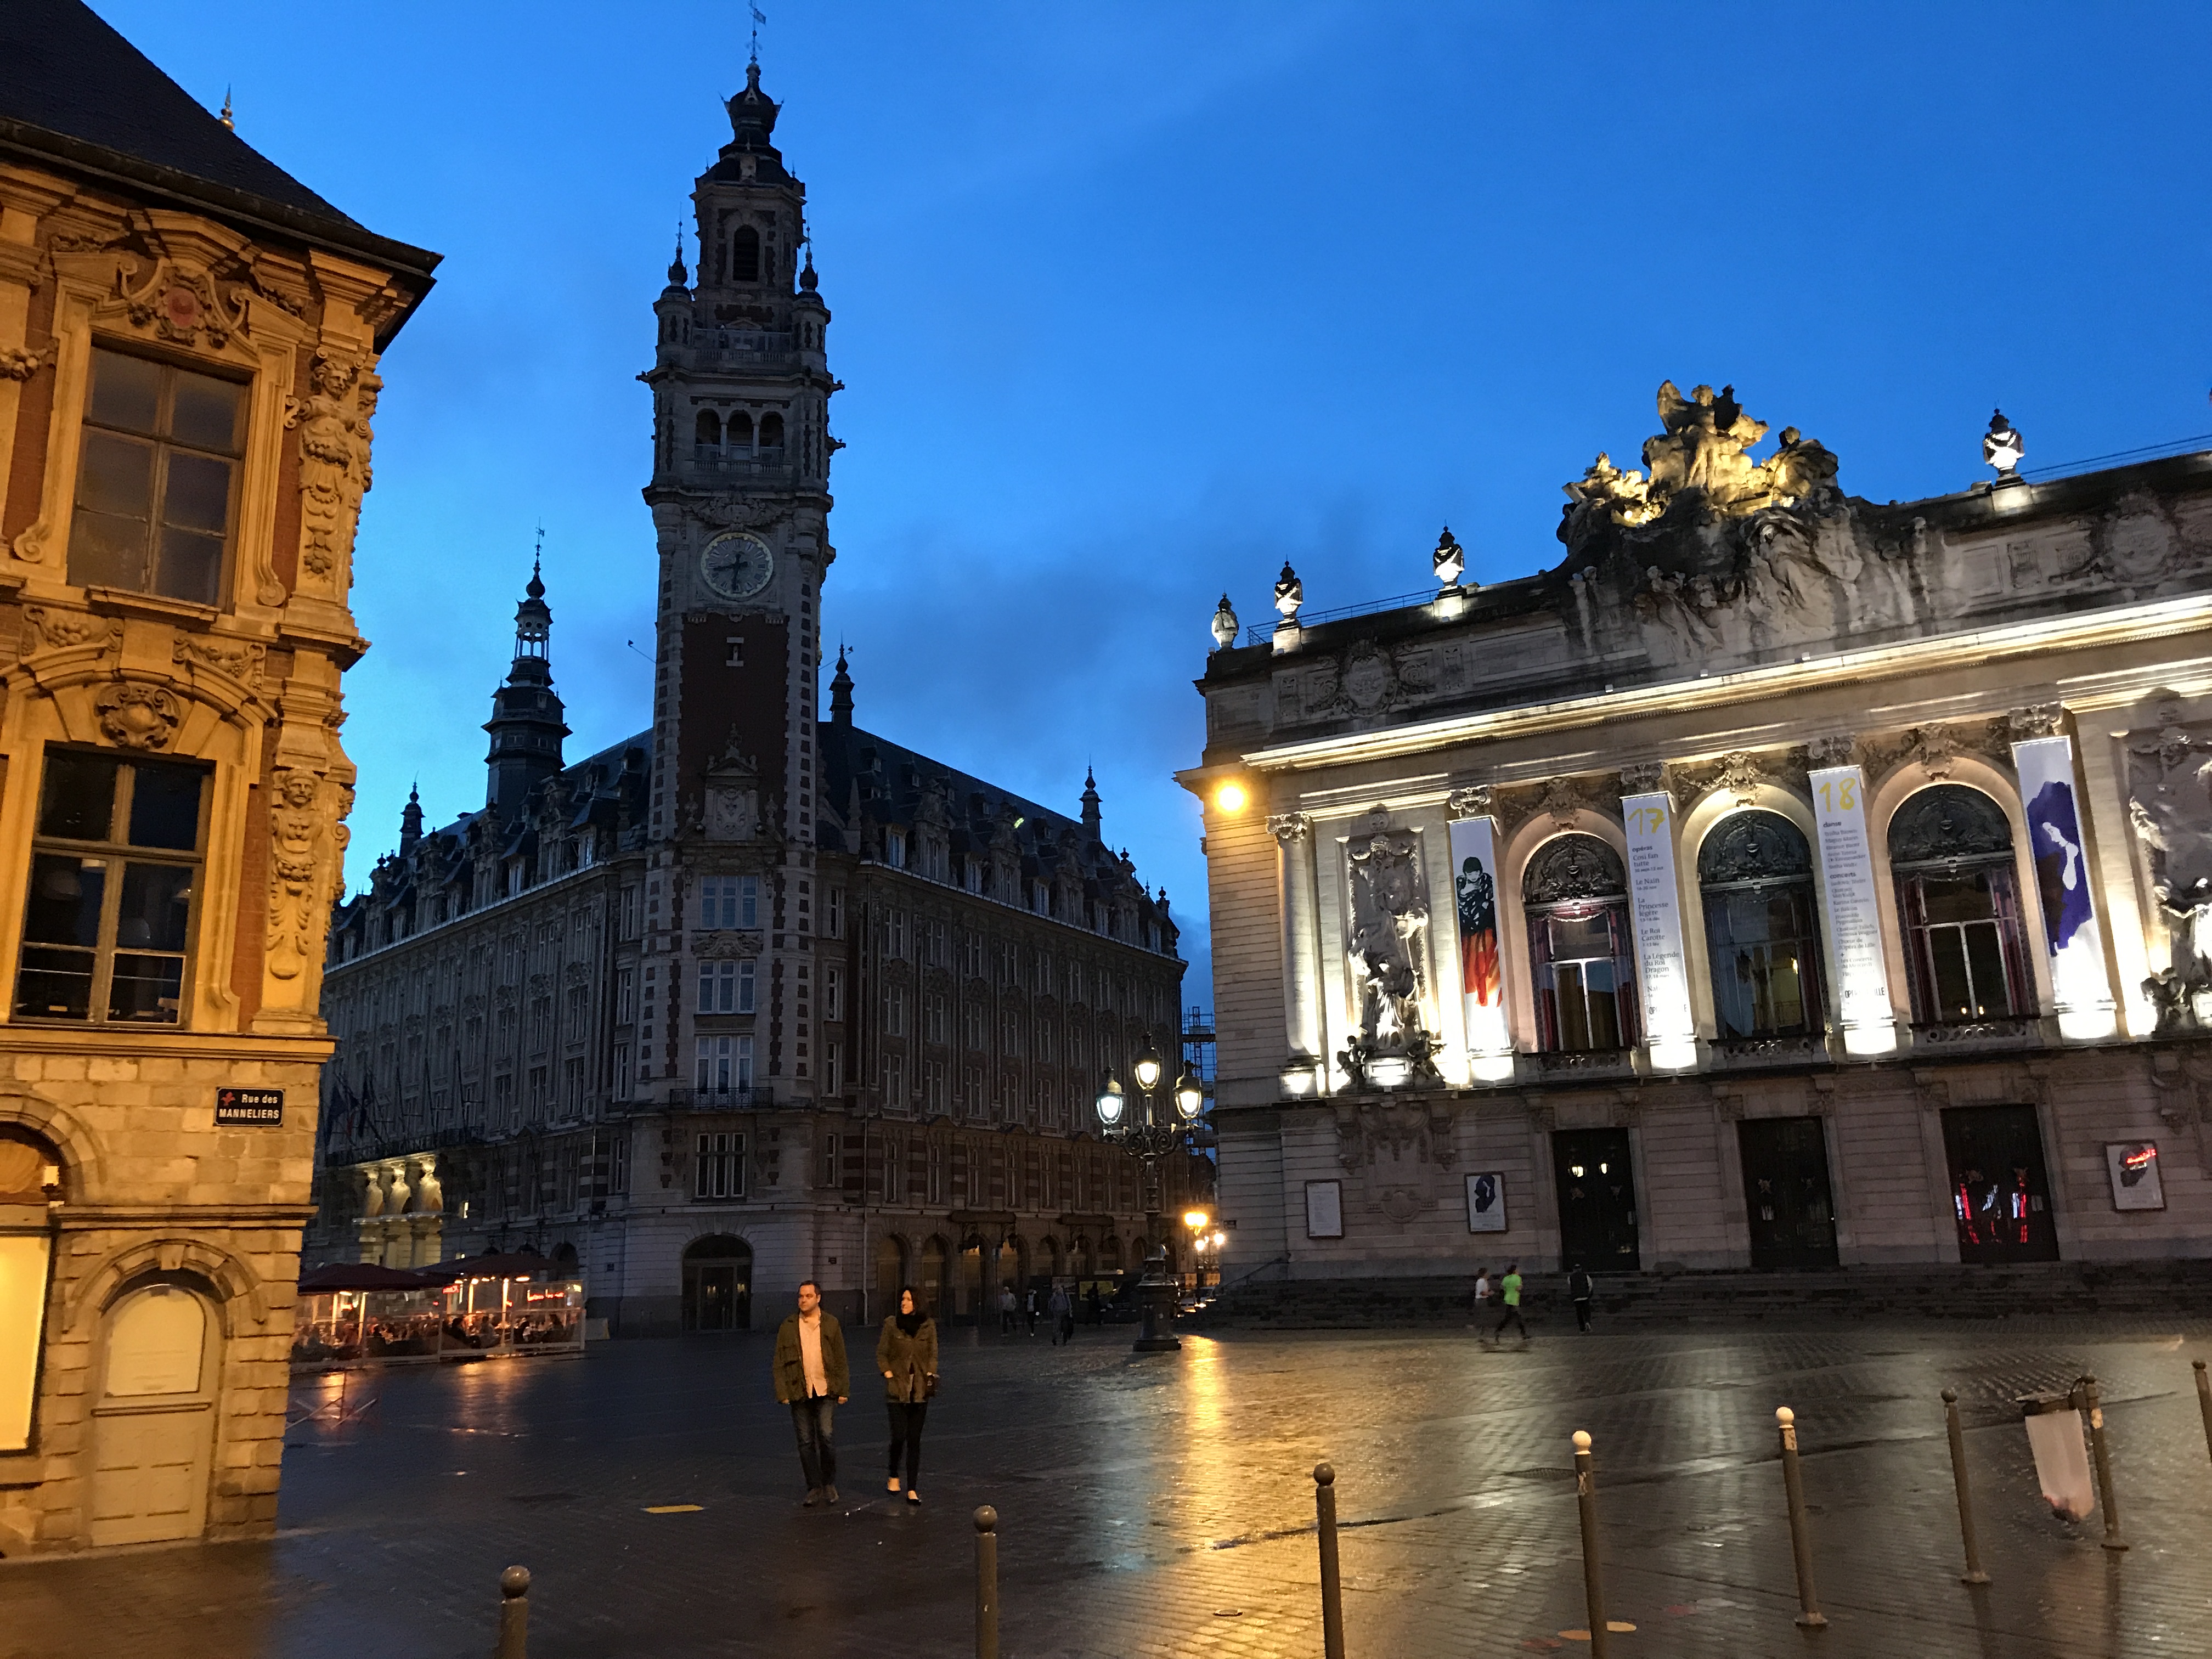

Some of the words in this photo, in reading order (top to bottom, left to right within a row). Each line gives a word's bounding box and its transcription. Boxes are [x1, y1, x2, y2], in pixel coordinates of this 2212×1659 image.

[1819, 777, 1855, 812] 18
[1628, 808, 1665, 836] 17
[1652, 951, 1680, 960] Légende
[241, 1093, 259, 1103] Rue
[262, 1094, 278, 1104] des
[219, 1108, 279, 1119] MANNELIERS
